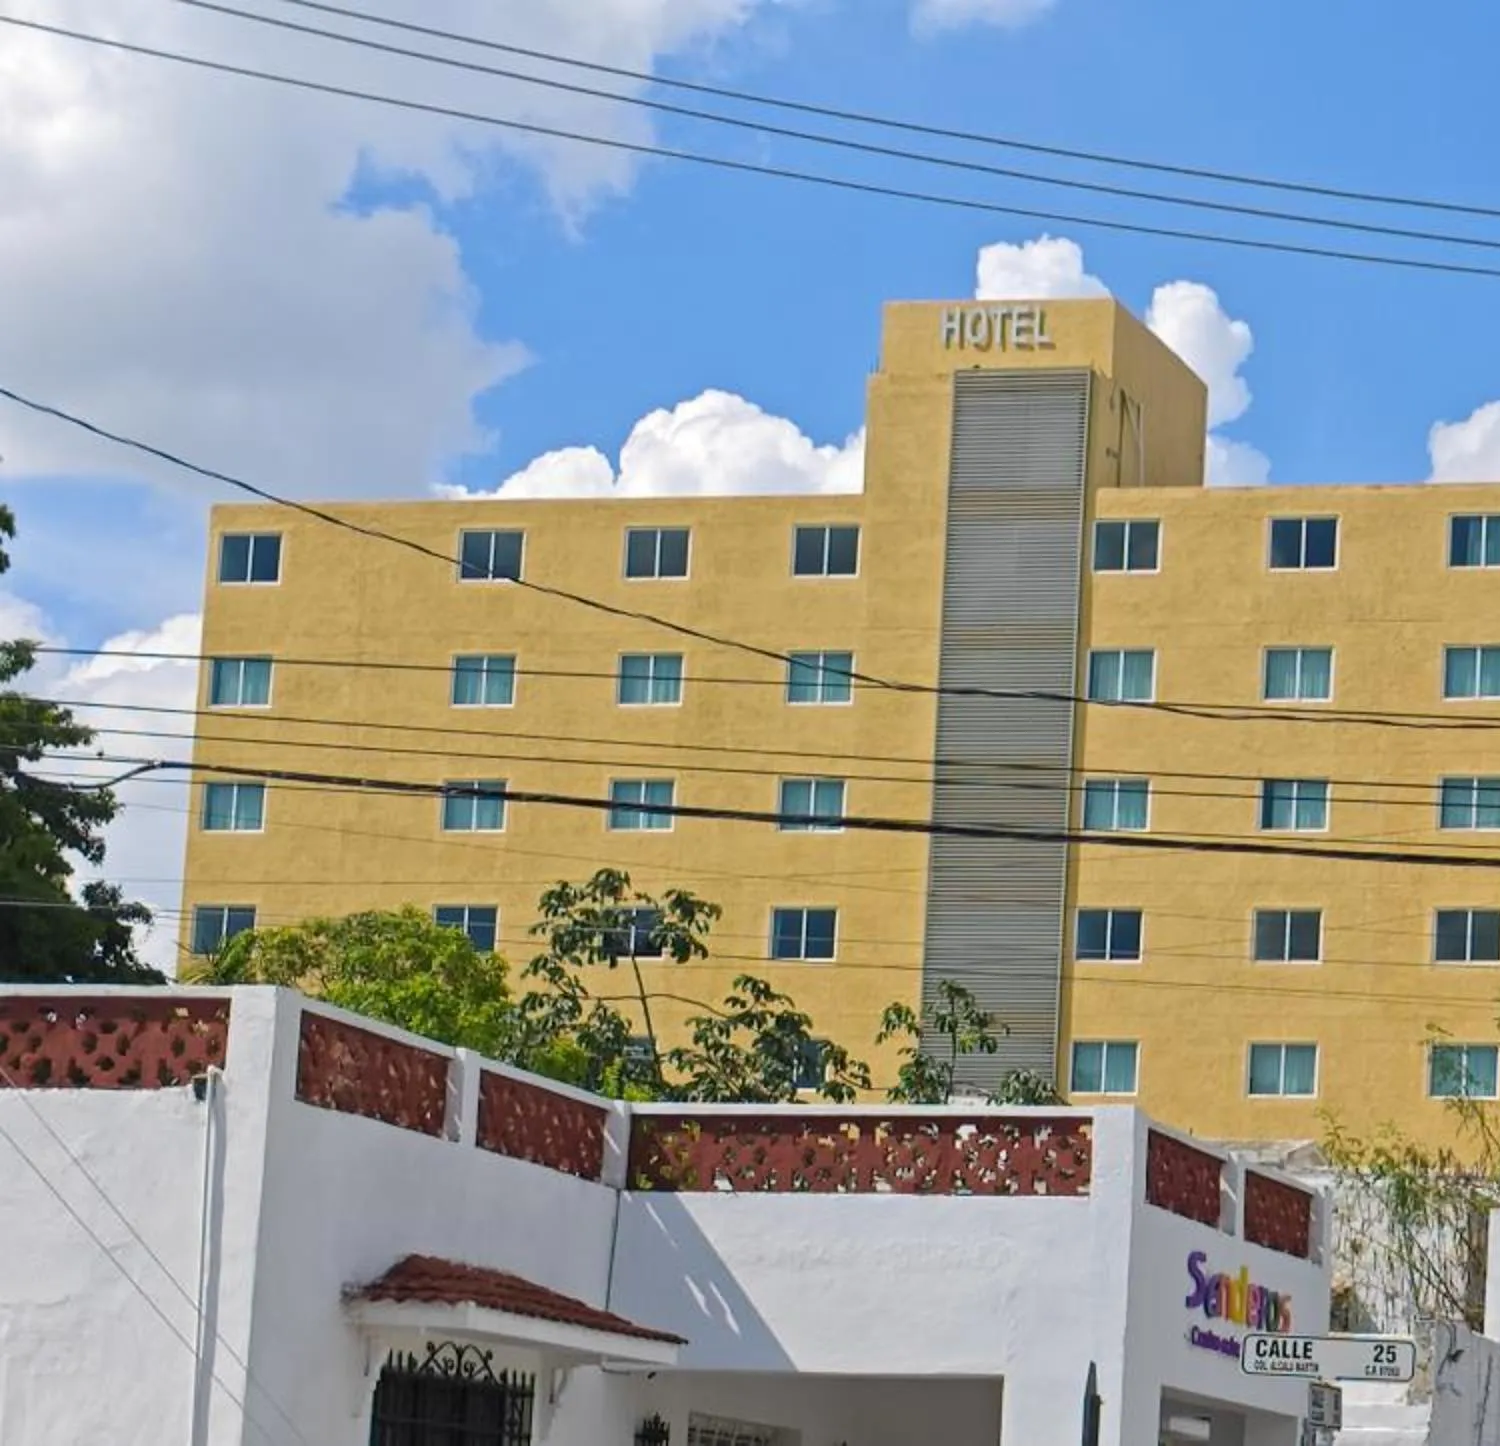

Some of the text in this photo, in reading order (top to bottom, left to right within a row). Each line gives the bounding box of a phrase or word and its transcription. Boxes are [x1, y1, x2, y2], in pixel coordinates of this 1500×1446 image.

[940, 305, 1053, 349] HOTEL
[1185, 1251, 1293, 1333] Senderos
[1256, 1339, 1313, 1359] CALLE
[1373, 1344, 1397, 1363] 25
